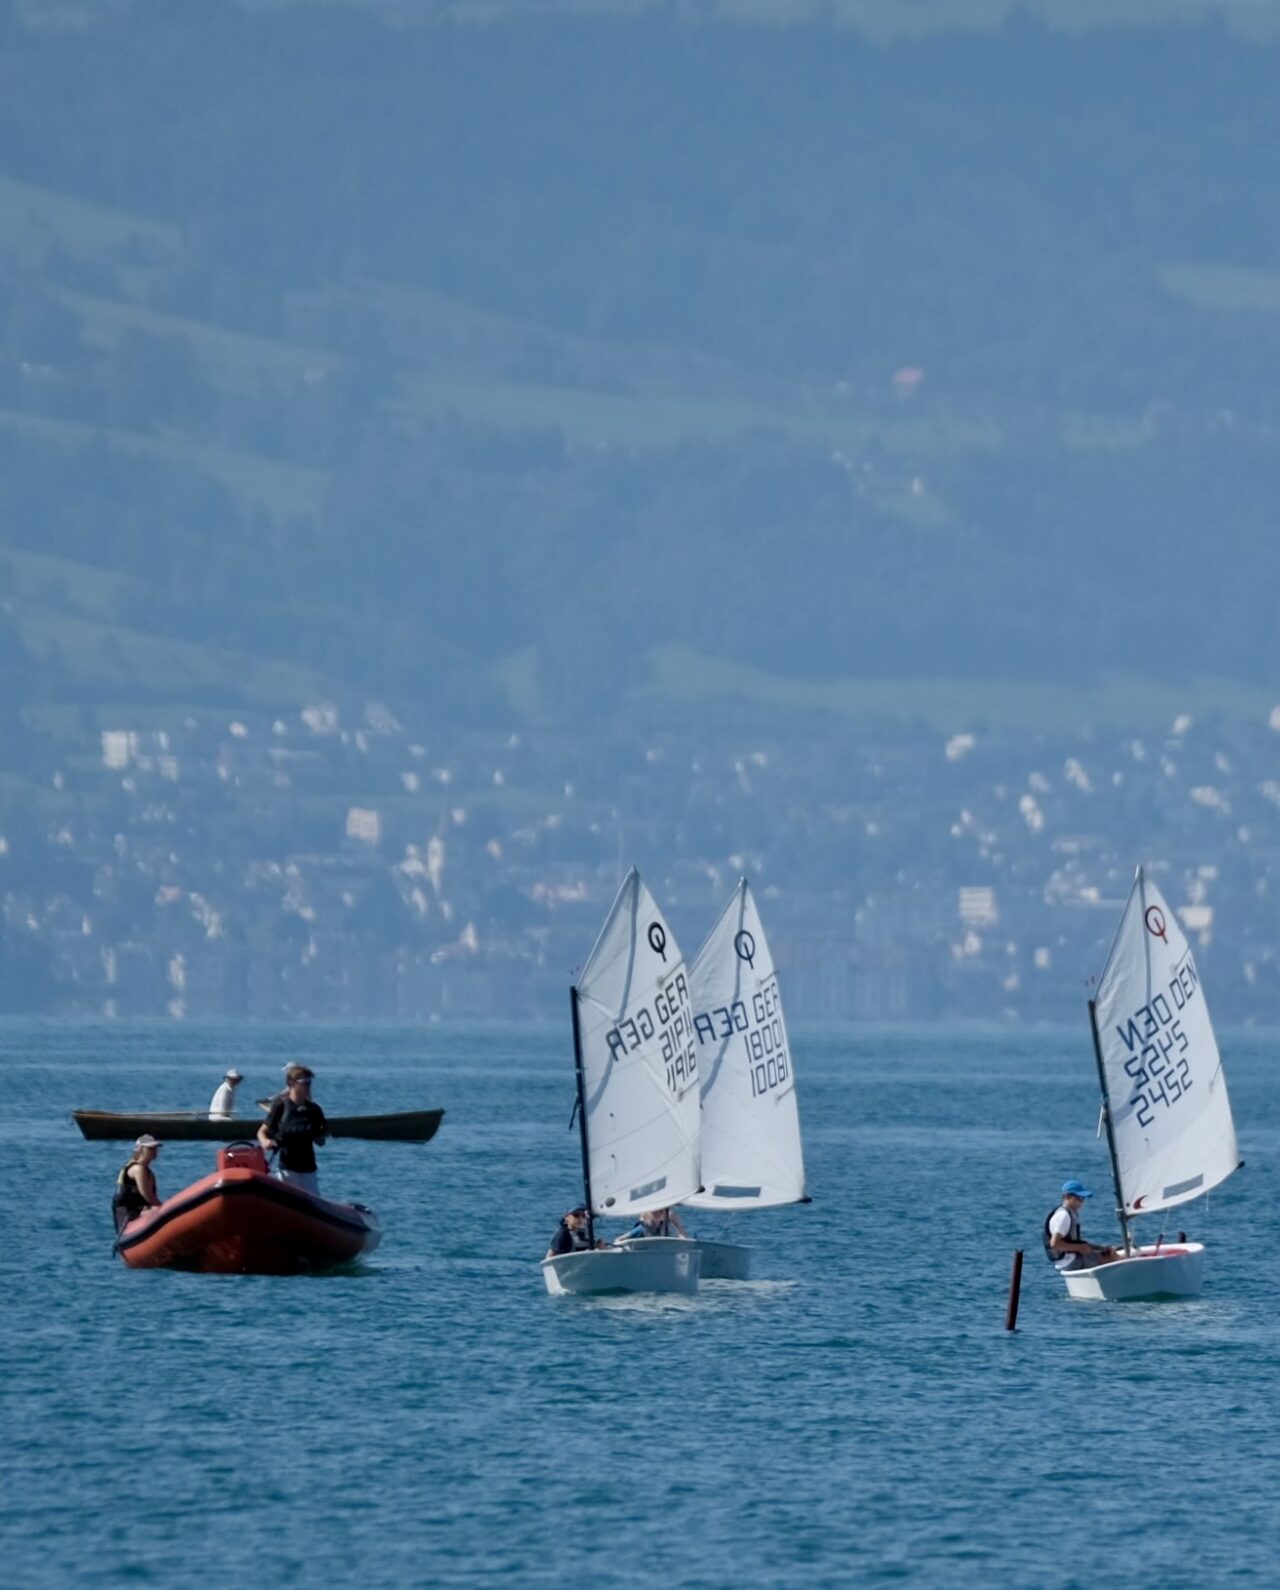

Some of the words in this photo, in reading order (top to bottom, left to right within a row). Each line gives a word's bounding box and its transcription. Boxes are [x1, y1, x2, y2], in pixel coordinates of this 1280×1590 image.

[654, 973, 688, 1025] GER
[1169, 963, 1198, 1011] DEN
[750, 1050, 789, 1098] 10081
[1130, 1058, 1193, 1128] 2452
